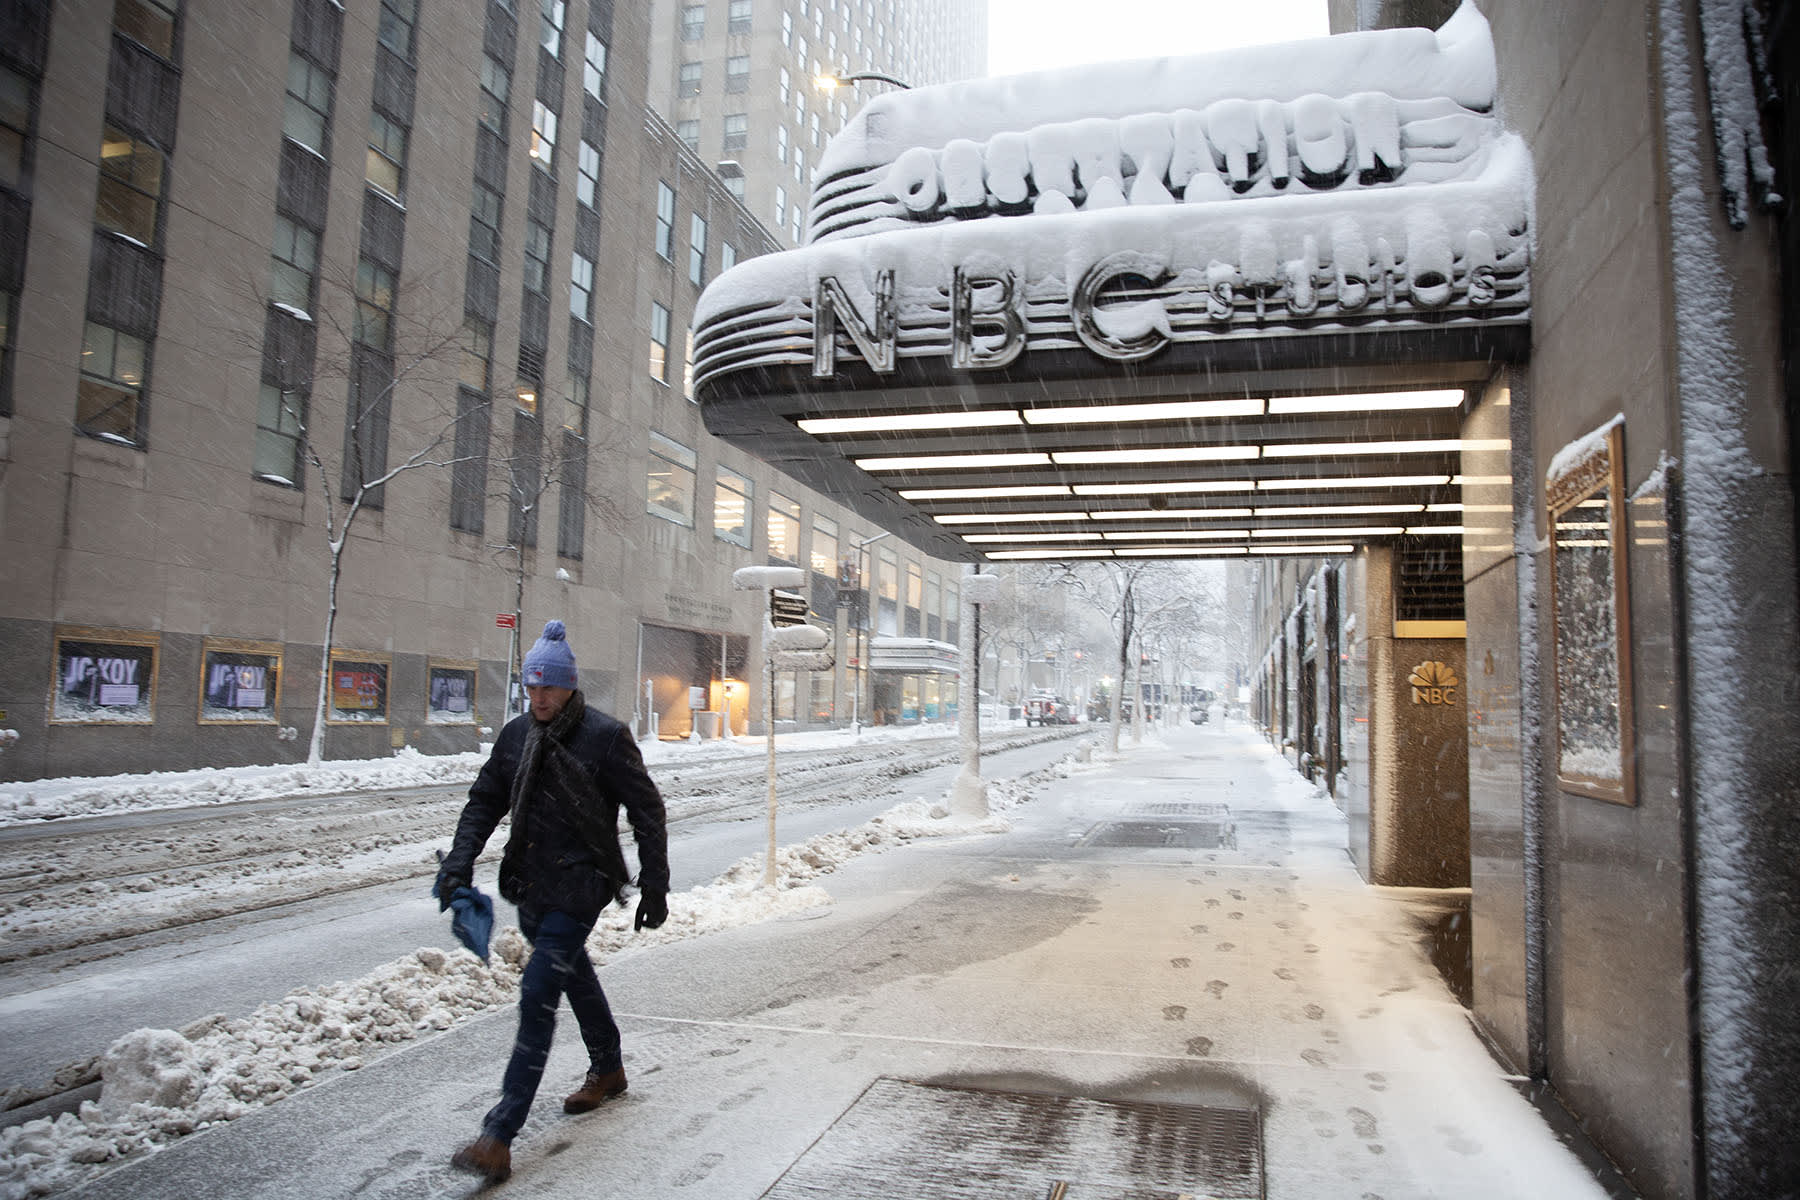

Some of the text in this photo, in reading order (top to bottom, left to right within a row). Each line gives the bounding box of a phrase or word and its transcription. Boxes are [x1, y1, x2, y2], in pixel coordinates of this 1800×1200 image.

[812, 250, 1497, 378] NBC STUDIOS
[1411, 687, 1456, 705] NBC
